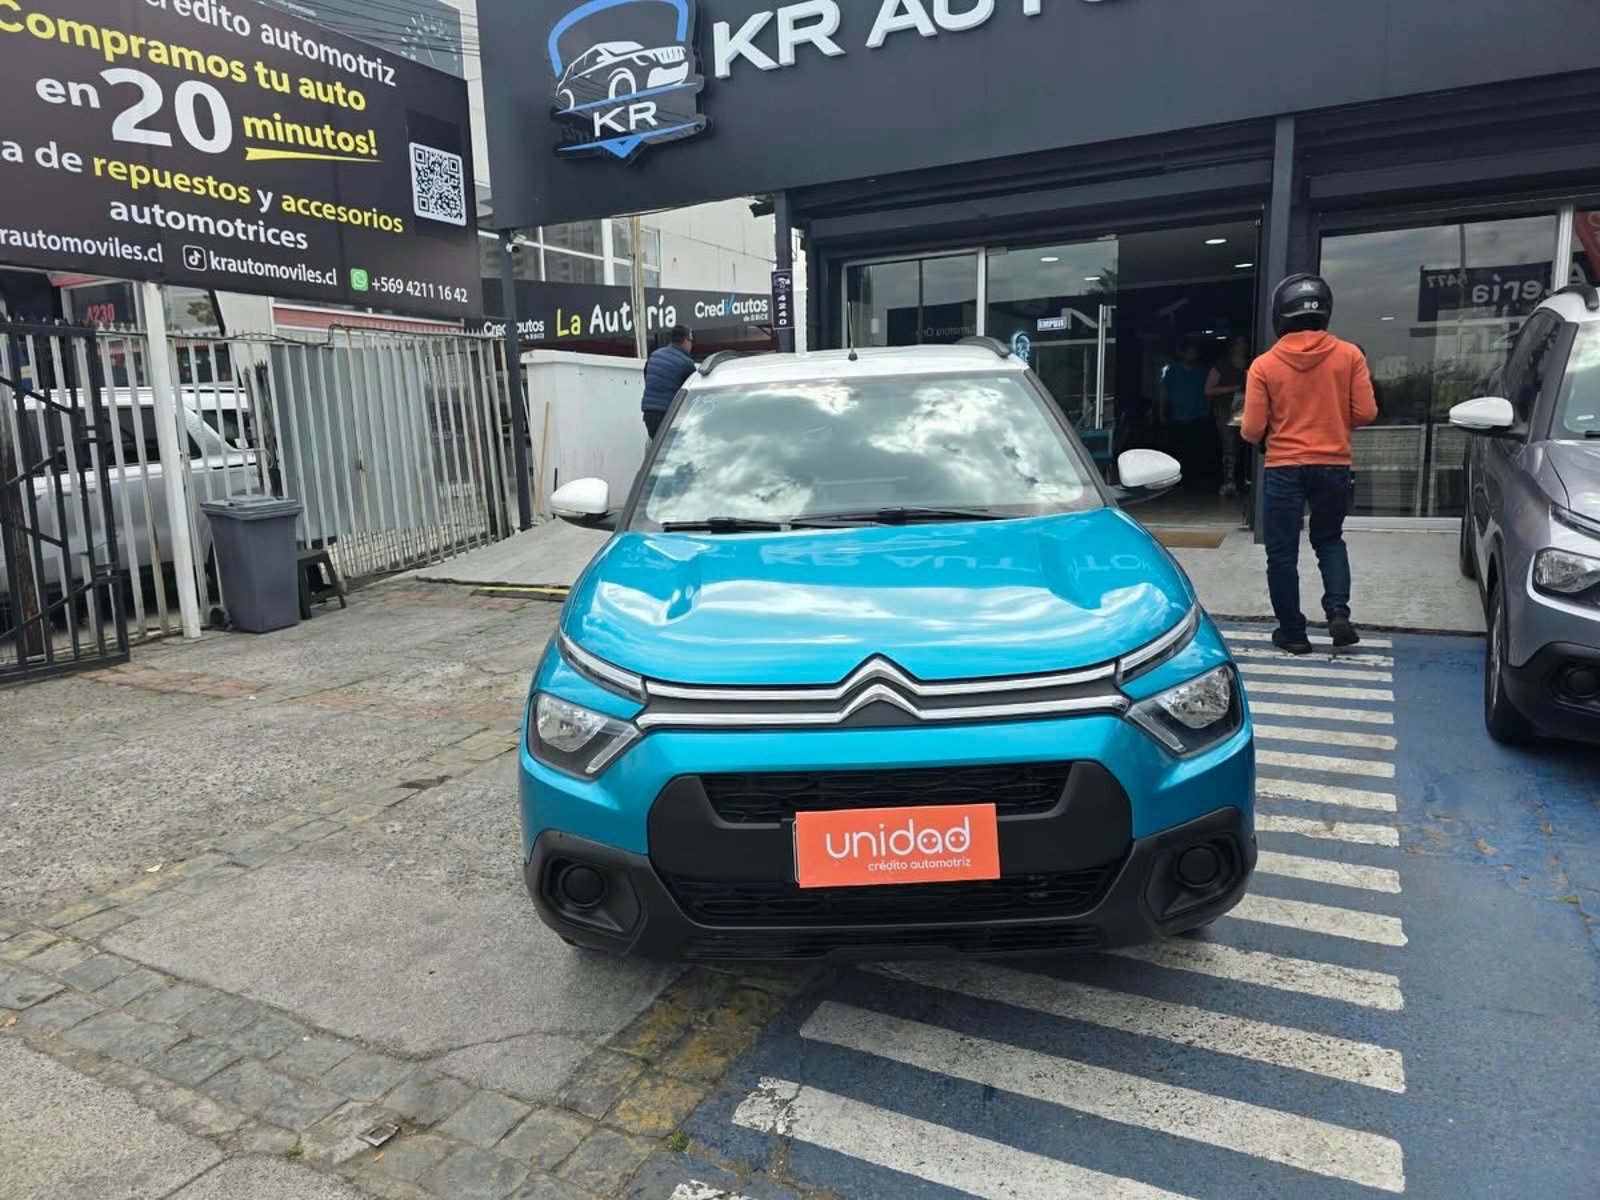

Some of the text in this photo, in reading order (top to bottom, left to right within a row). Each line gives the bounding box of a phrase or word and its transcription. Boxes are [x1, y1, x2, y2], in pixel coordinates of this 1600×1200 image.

[0, 0, 248, 83] Compramos
[254, 61, 290, 94] tu
[298, 77, 367, 111] auto
[260, 23, 397, 87] automotriz
[713, 0, 846, 79] KR
[35, 67, 378, 156] en 20 minutos!
[593, 101, 658, 137] KR
[35, 141, 83, 173] de
[93, 157, 251, 204] repuestos
[256, 188, 273, 214] y
[281, 194, 404, 233] accesorios
[0, 228, 163, 264] rautomoviles.cl
[110, 200, 308, 250] automotrices
[210, 250, 337, 287] krautomoviles.cl
[371, 276, 404, 295] +569
[406, 279, 434, 299] 4211
[556, 295, 677, 337] La Autría
[826, 816, 971, 859] unidad
[868, 858, 971, 871] crédito automotriz
